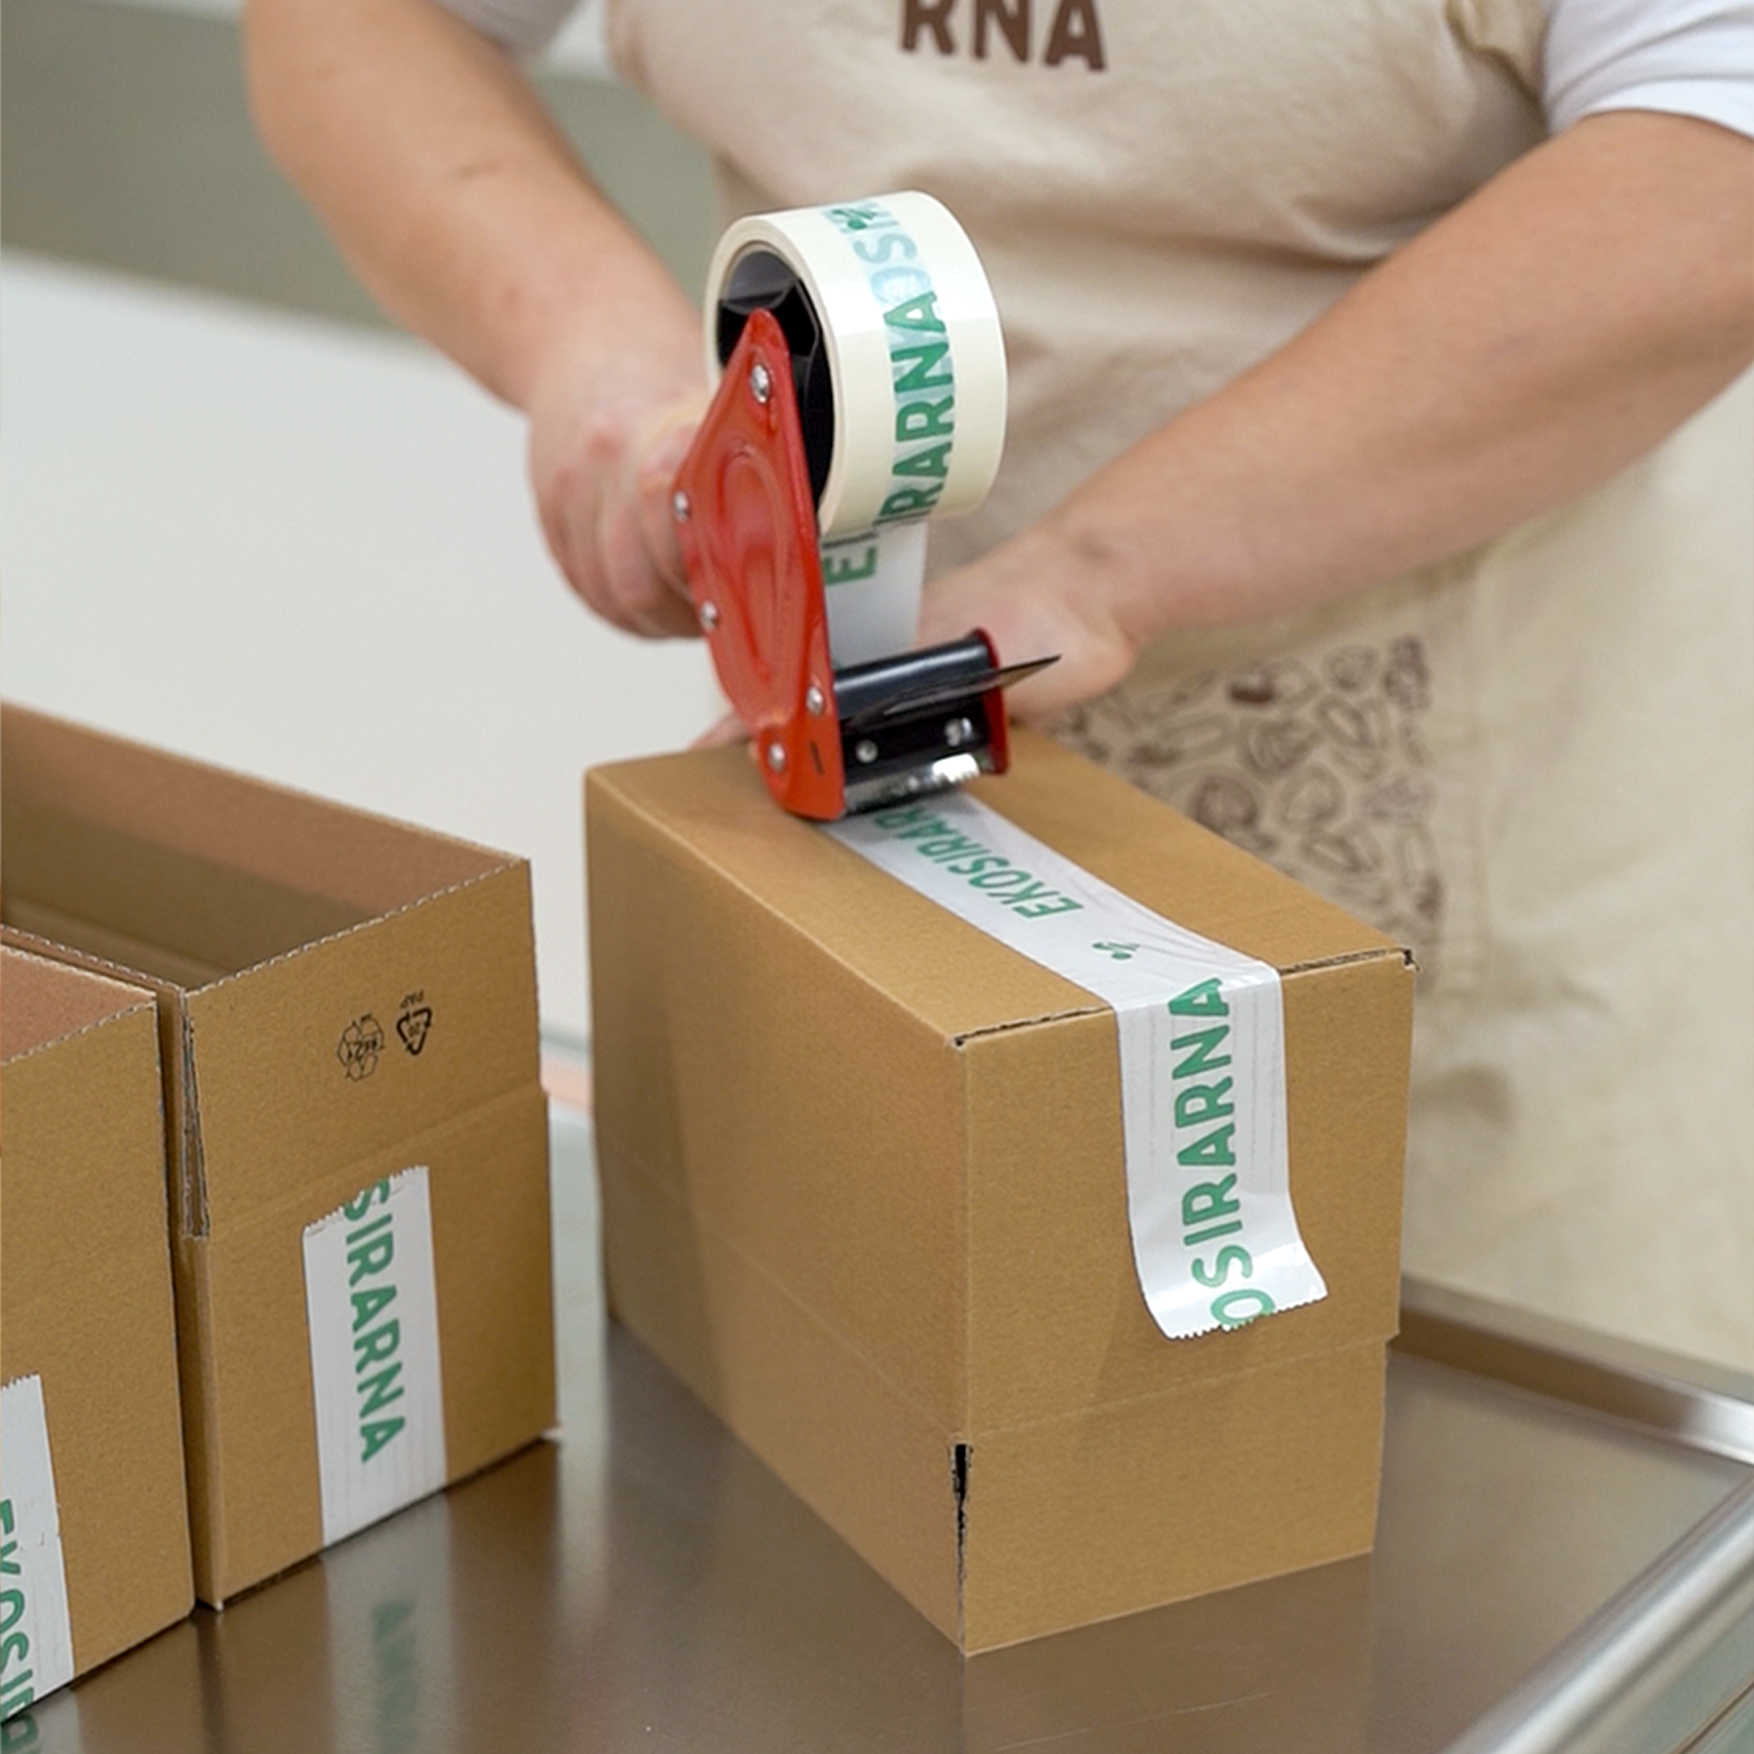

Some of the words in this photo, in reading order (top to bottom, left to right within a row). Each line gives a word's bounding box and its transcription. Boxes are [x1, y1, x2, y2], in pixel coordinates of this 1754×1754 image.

[901, 0, 1107, 72] RNA
[1167, 977, 1276, 1330] OSIRARNA
[344, 1178, 406, 1463] SIRARNA
